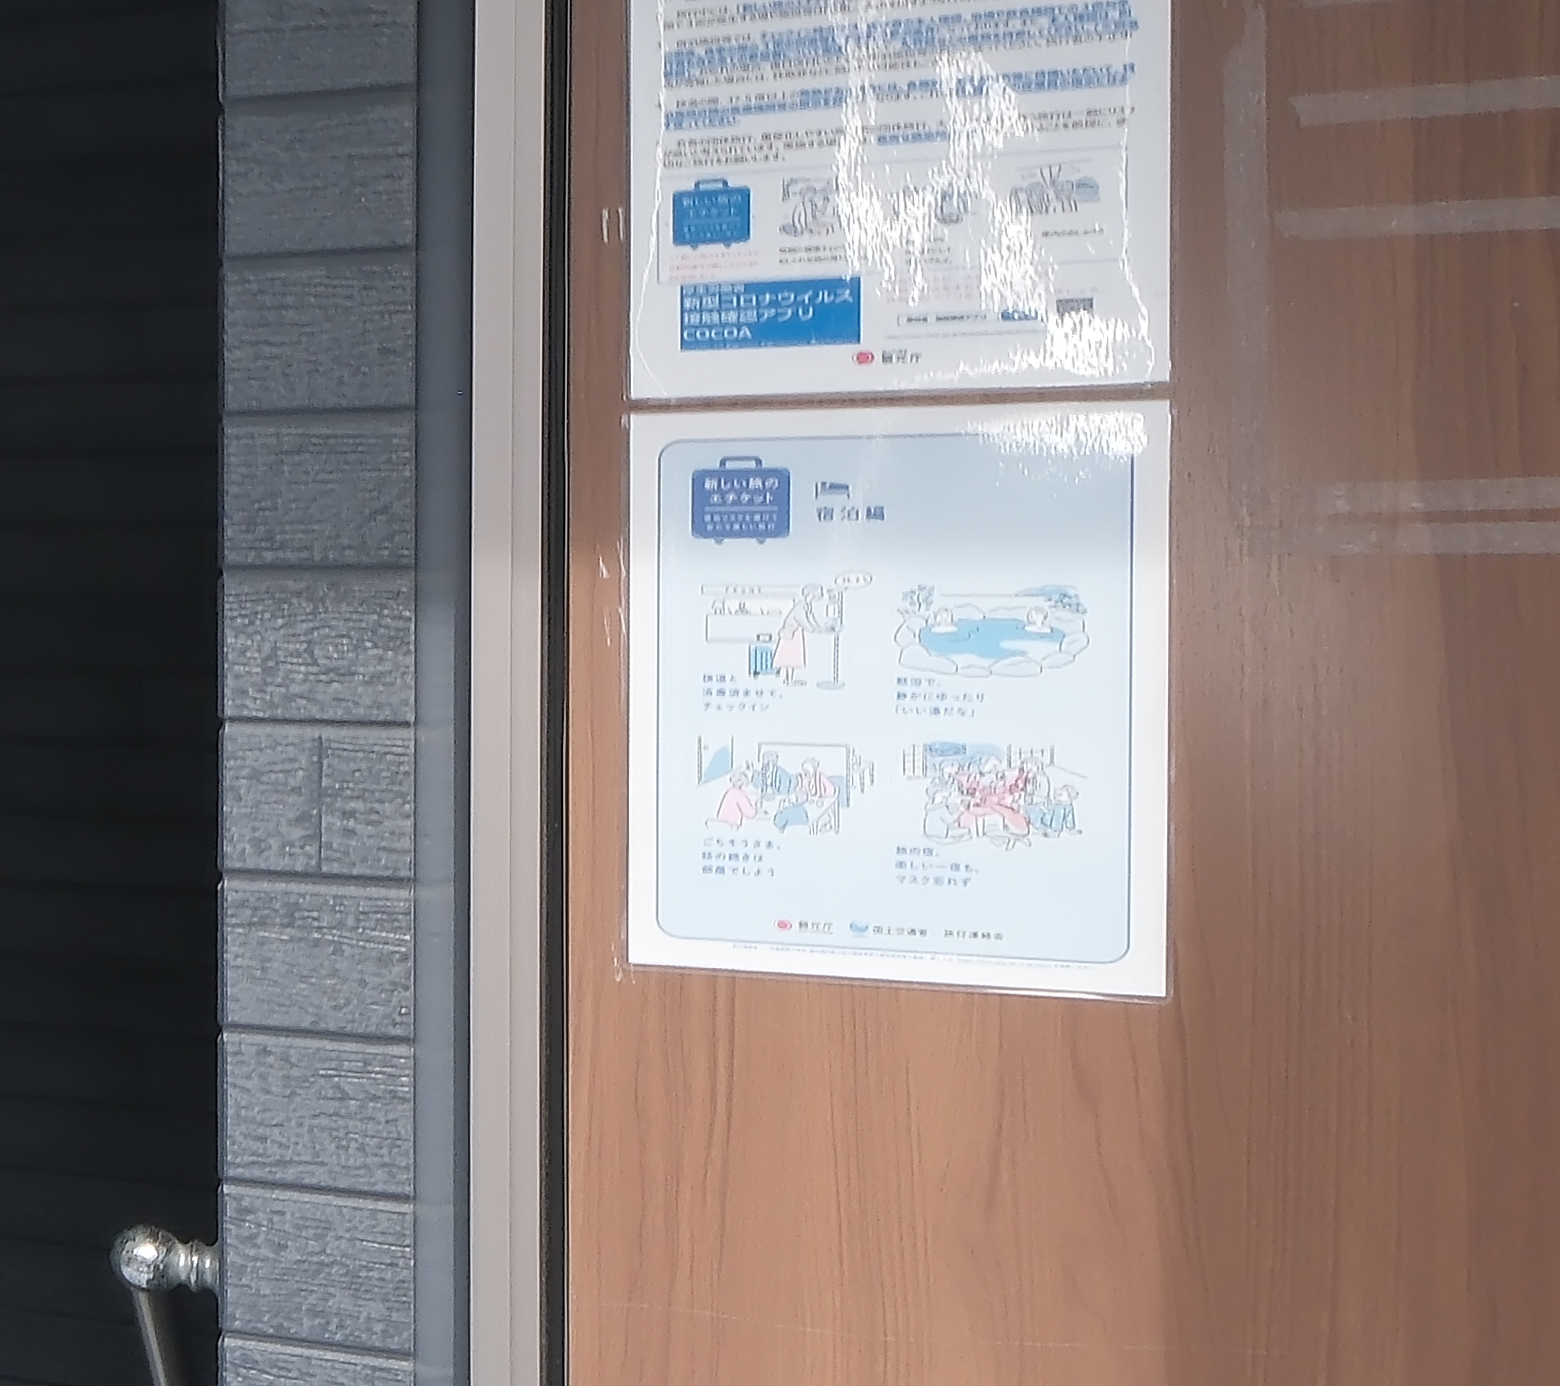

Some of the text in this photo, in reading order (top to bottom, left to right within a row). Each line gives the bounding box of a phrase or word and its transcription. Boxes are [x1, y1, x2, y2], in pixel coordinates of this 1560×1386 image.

[682, 289, 853, 310] 新型コロナウイルス
[682, 324, 752, 342] COCOA
[703, 476, 779, 492] 新しい旅の
